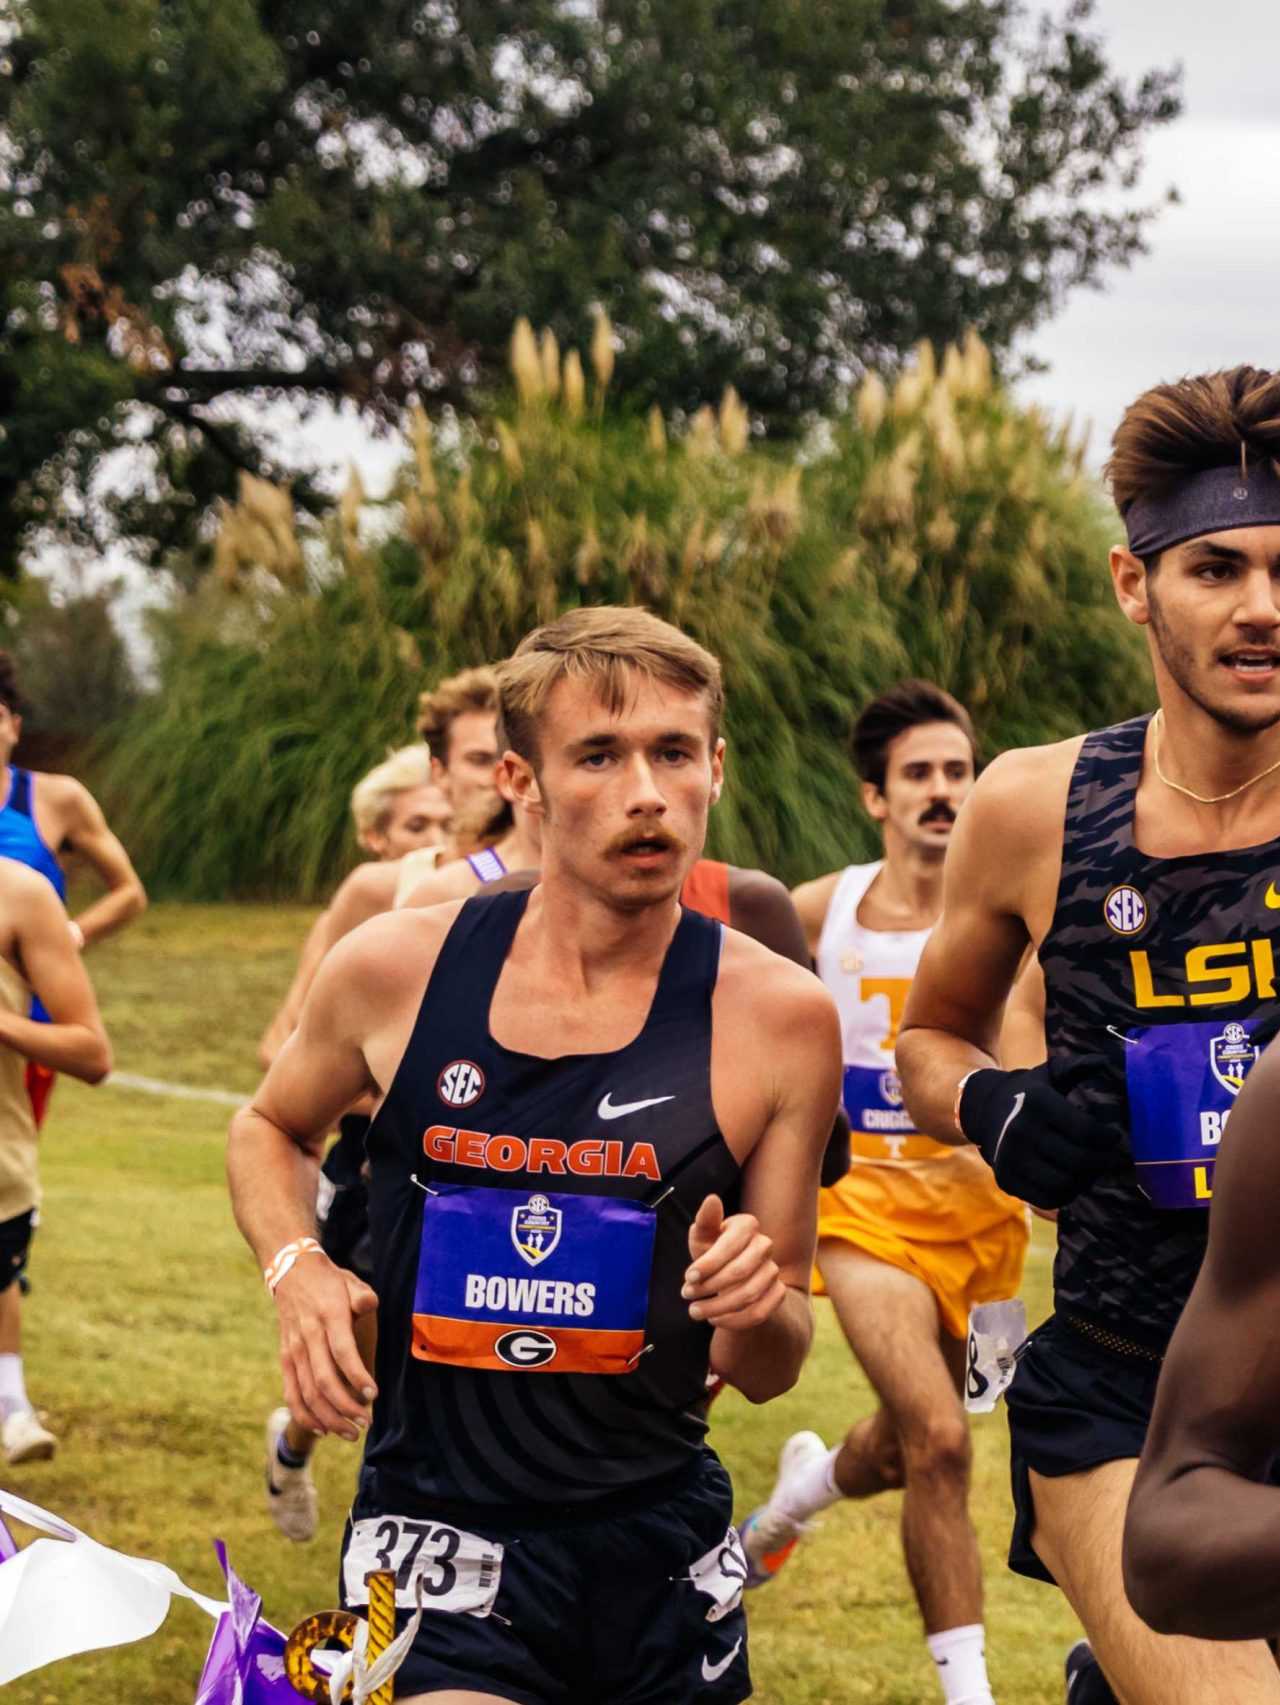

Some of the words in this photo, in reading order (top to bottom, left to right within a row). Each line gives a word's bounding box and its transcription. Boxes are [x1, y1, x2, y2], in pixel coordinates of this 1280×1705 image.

[1106, 888, 1146, 932] SEC
[440, 1063, 482, 1105] SEC
[423, 1125, 661, 1181] GEORGIA
[465, 1274, 597, 1317] BOWERS
[364, 1520, 461, 1597] 373
